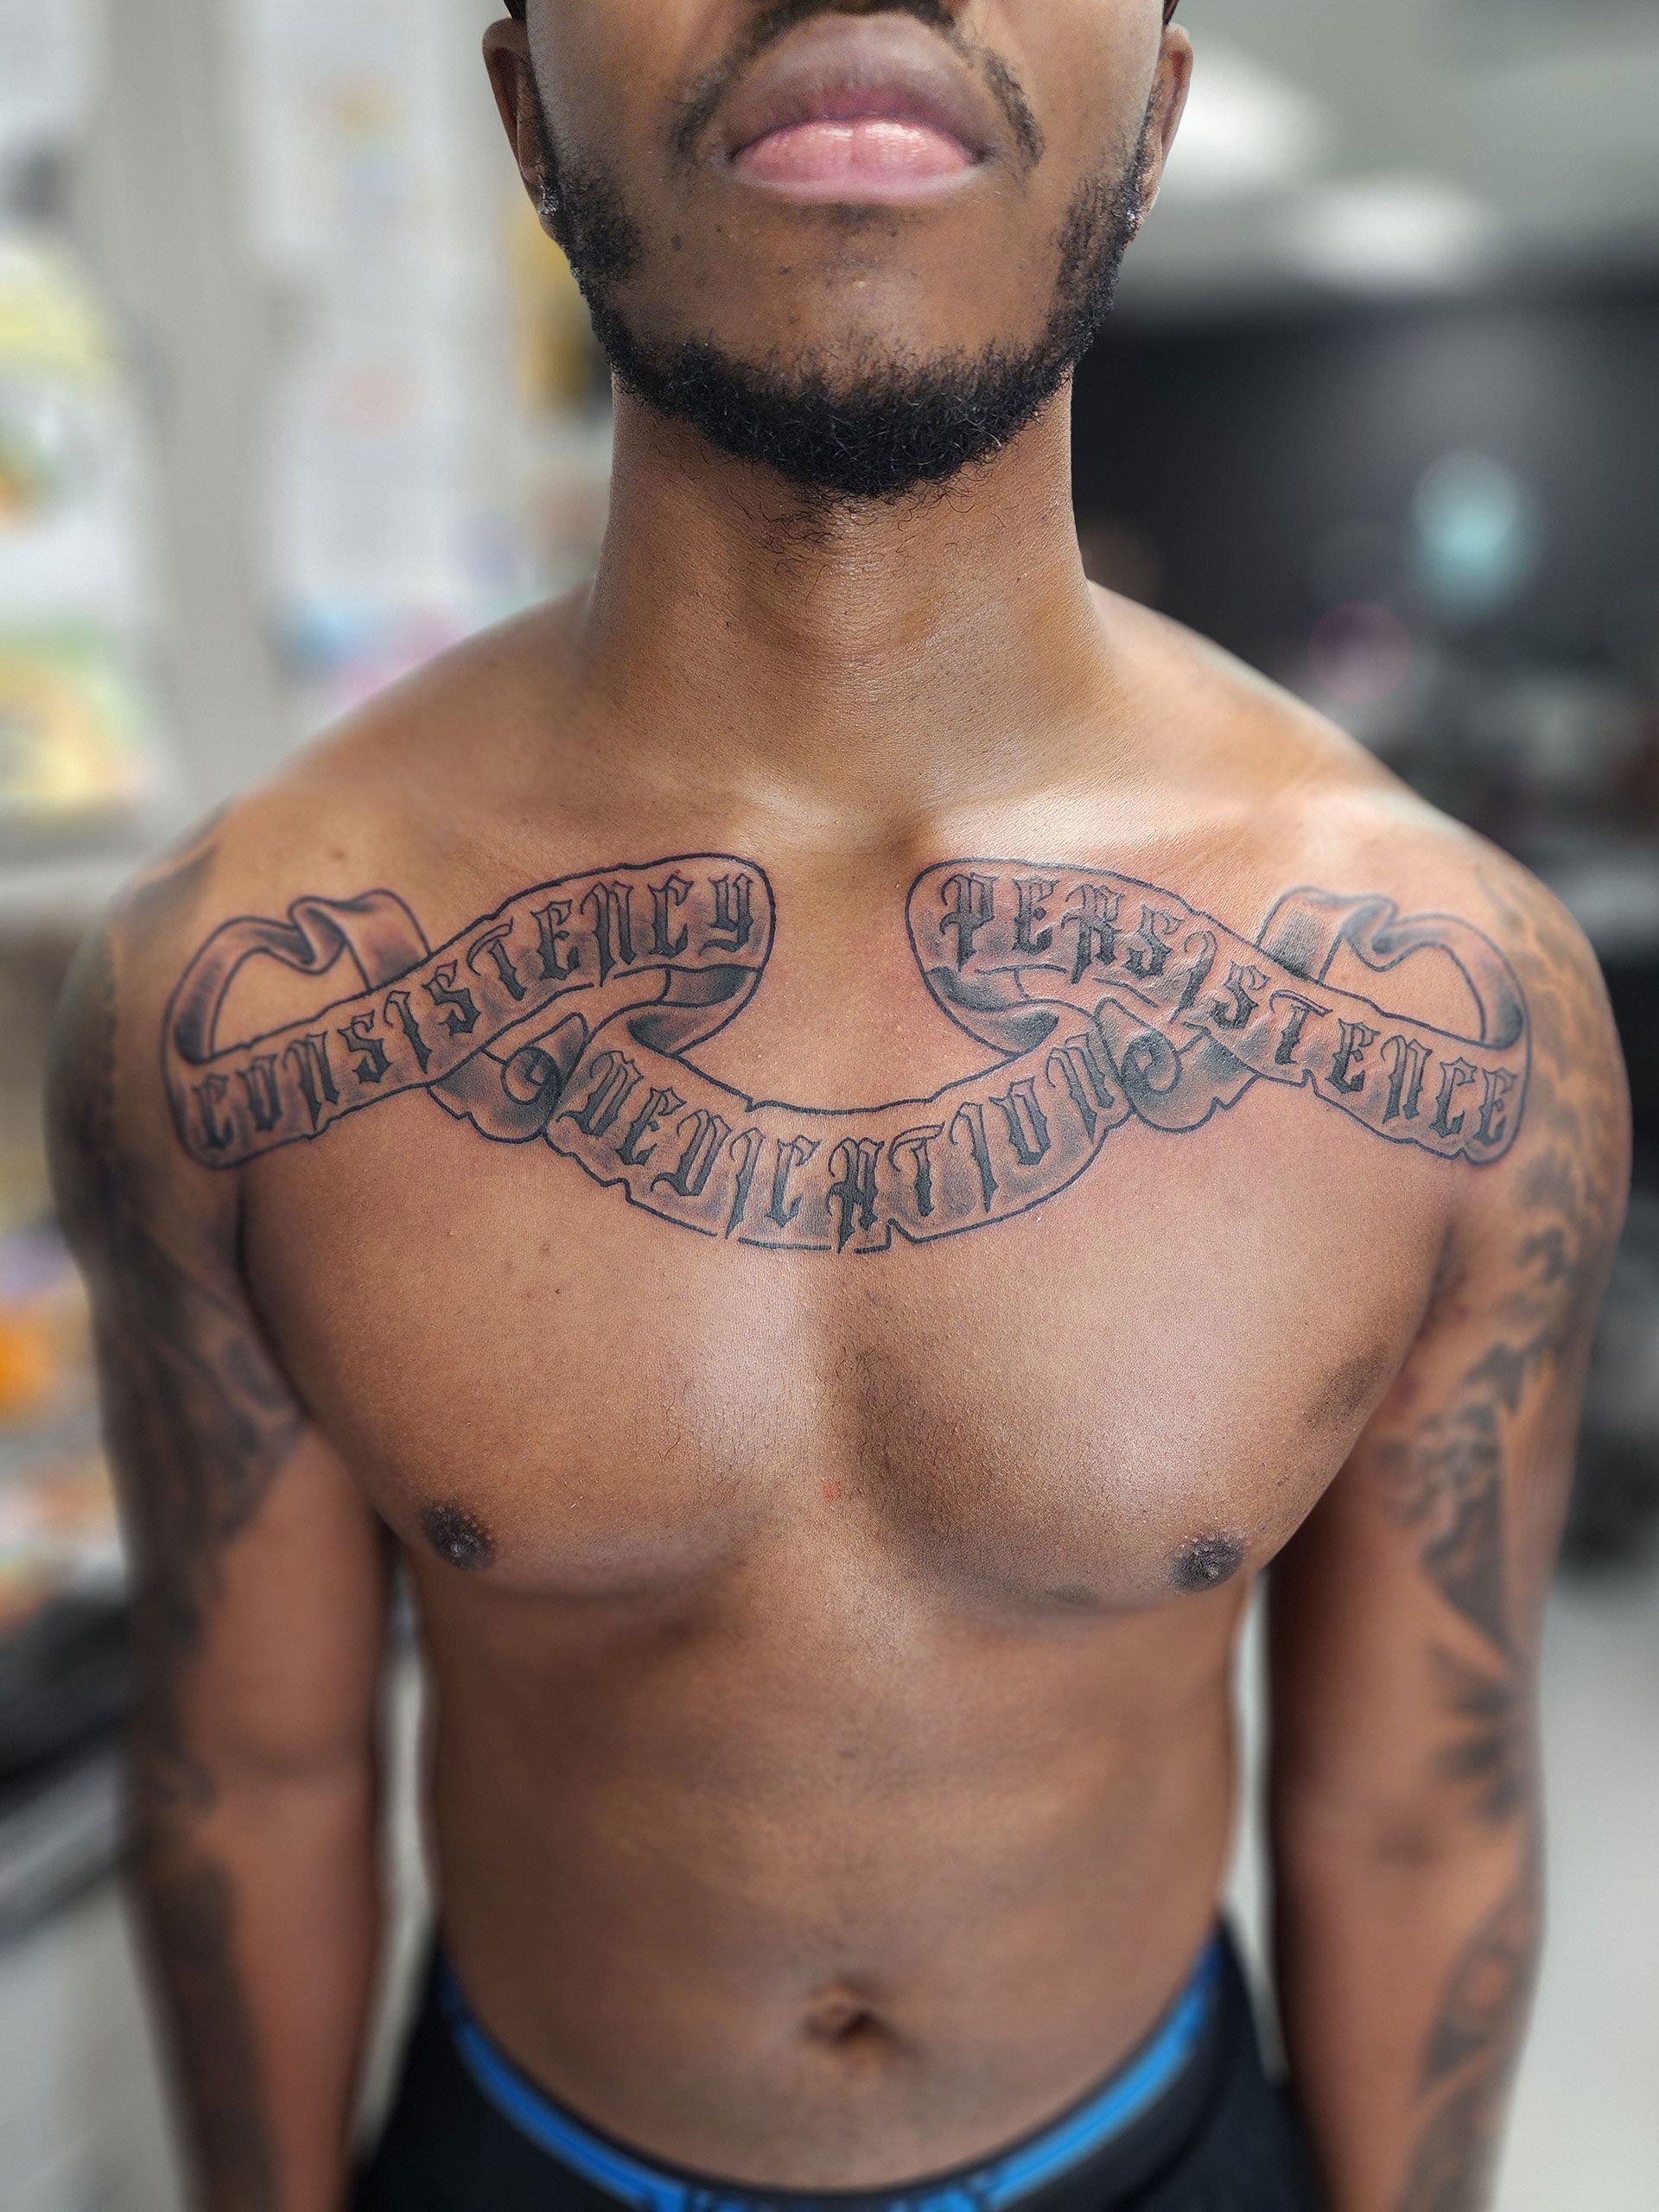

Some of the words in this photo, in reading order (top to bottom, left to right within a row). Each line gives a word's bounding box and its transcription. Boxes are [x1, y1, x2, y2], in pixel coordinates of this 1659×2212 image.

[190, 872, 755, 1149] CONSISTENCY
[559, 1033, 1116, 1253] DEDICATION
[940, 872, 1518, 1147] PERSISTENCE
